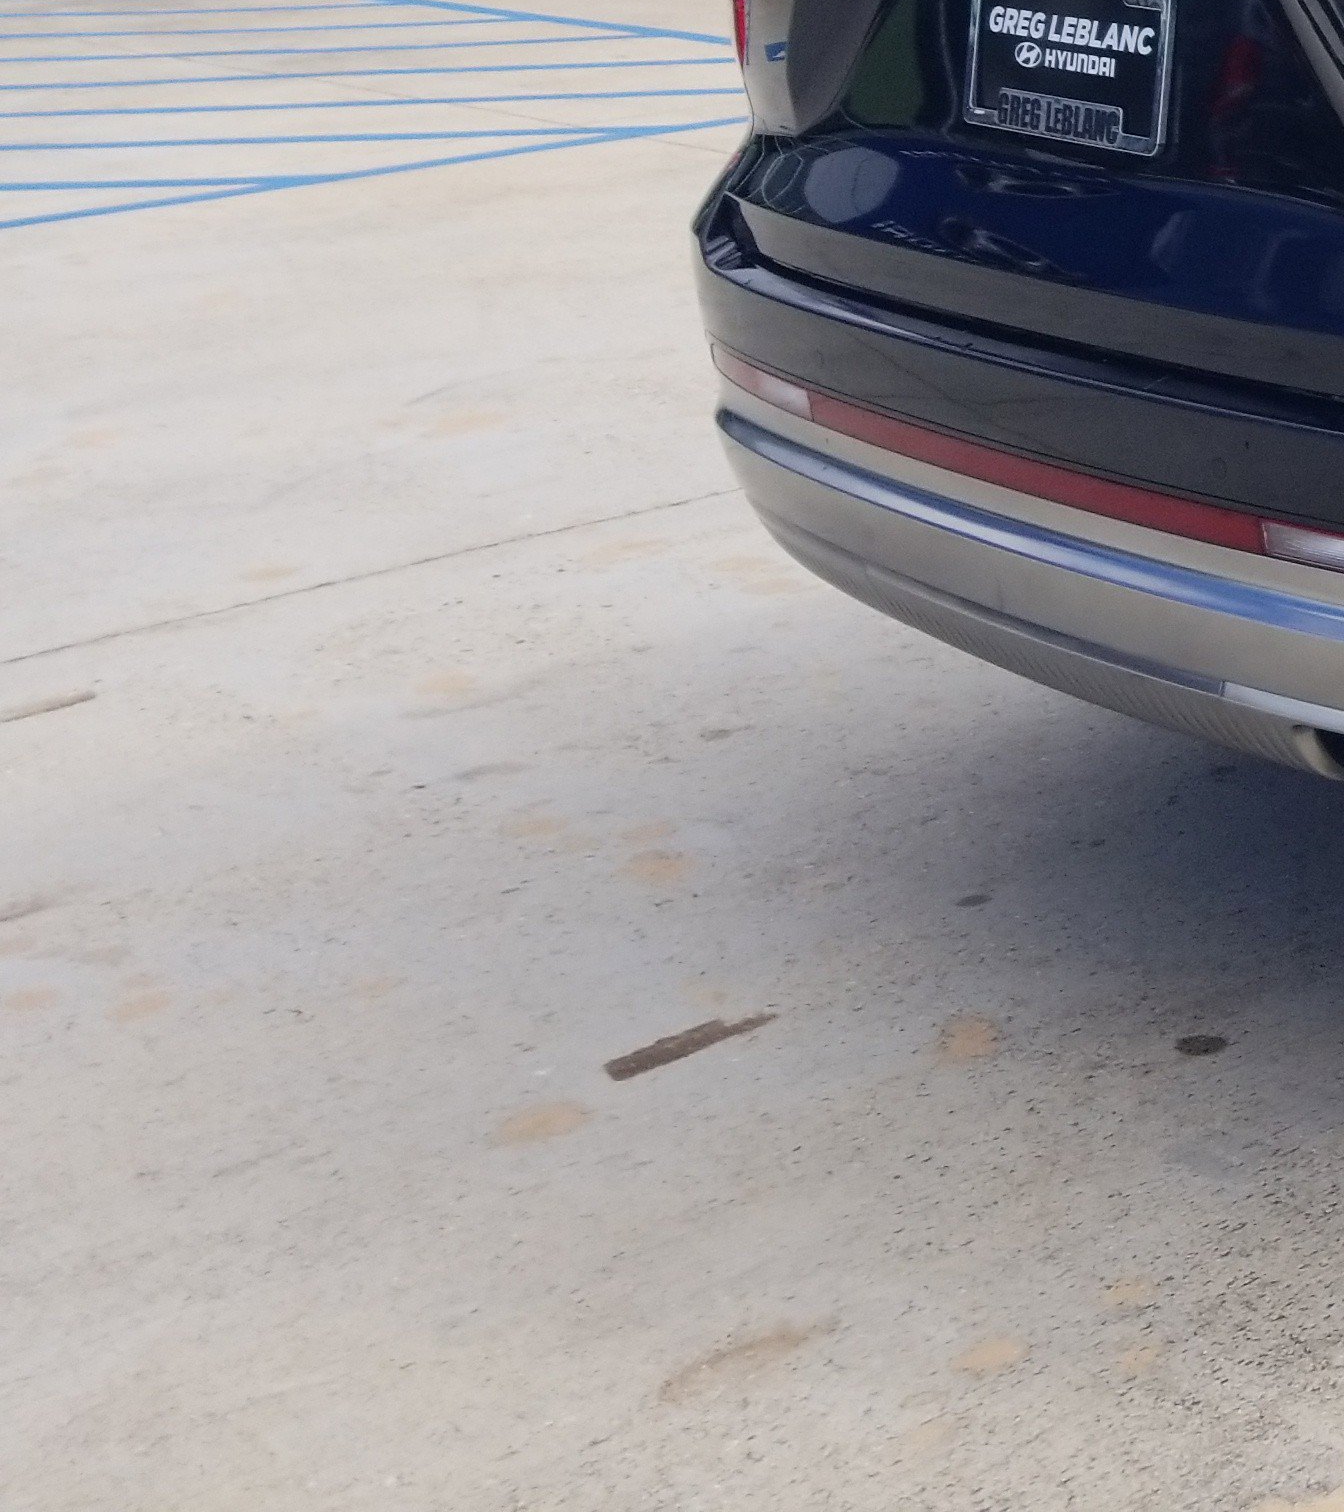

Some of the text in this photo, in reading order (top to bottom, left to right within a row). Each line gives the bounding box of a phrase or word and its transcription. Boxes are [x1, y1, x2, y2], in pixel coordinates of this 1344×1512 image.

[989, 6, 1154, 55] GREG LEBLANC
[1044, 48, 1116, 78] HYUNDAI
[998, 92, 1042, 131] GREG
